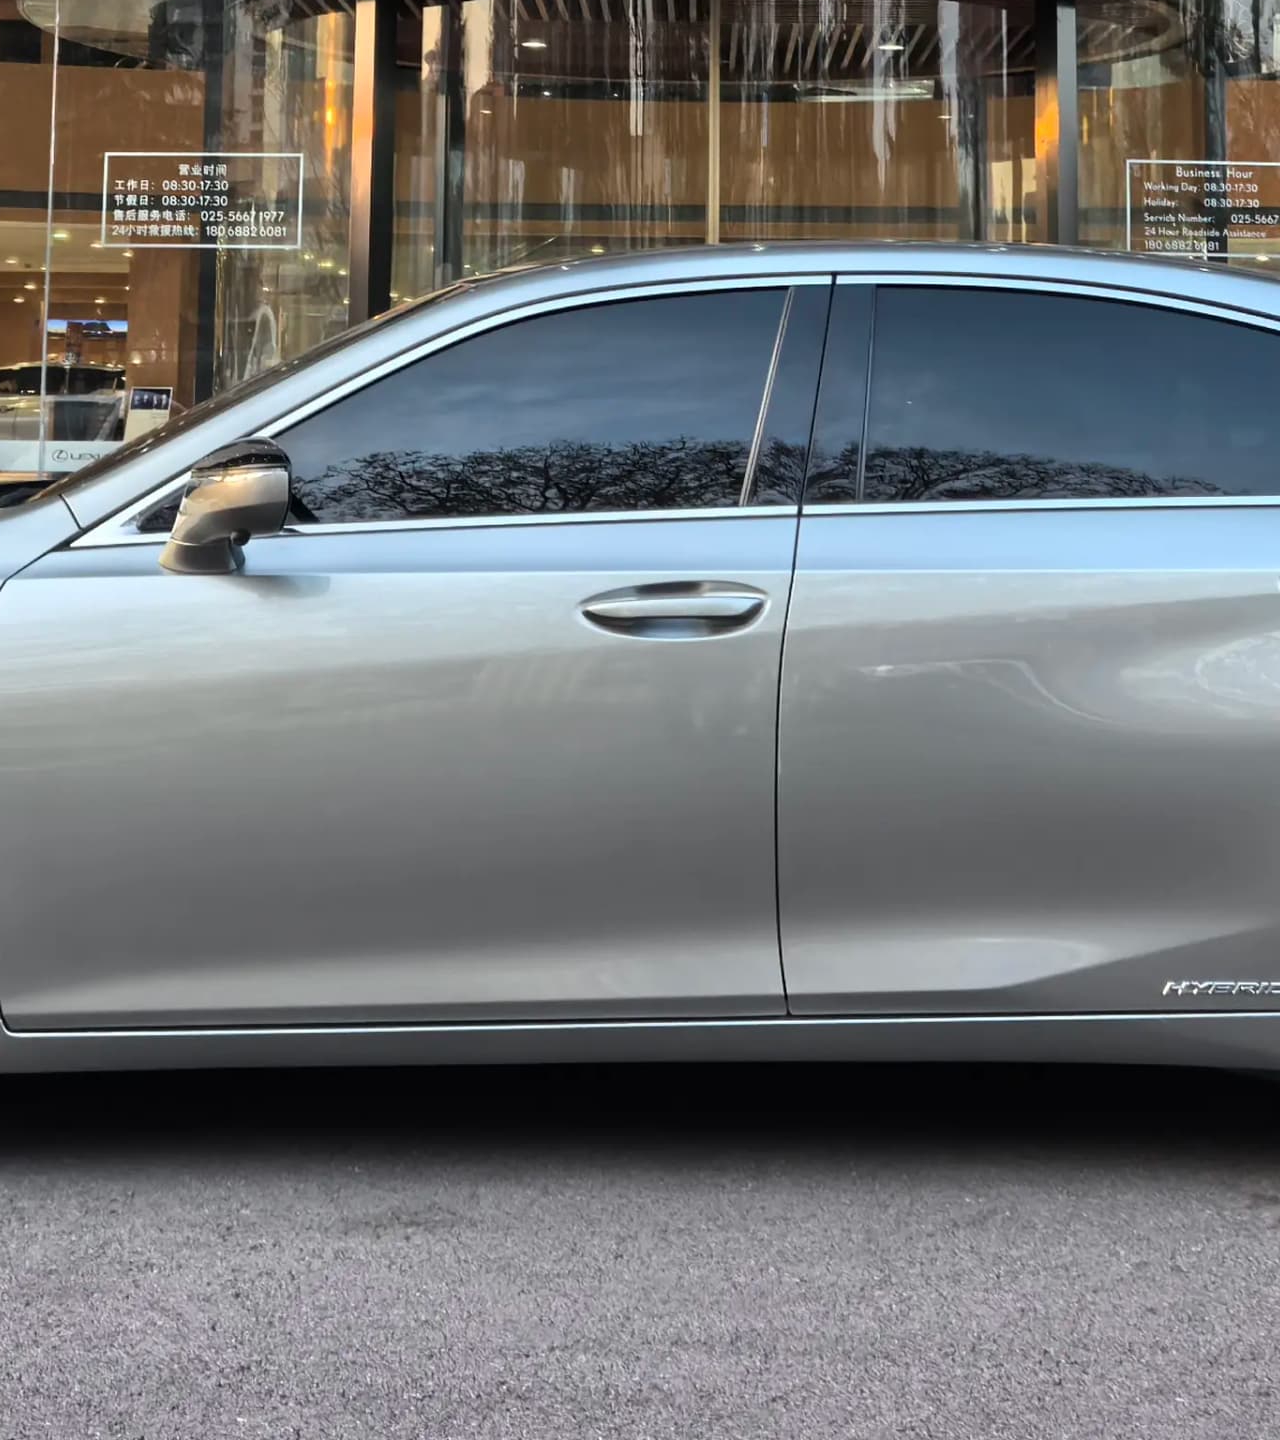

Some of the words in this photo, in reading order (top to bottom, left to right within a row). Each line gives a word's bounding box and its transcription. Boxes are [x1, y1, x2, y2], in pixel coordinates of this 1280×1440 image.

[178, 164, 227, 177] 营业时间
[1175, 166, 1220, 178] Business
[1226, 168, 1254, 179] Hour
[162, 180, 229, 191] 08:30-17:30
[1144, 182, 1179, 192] Working
[1203, 183, 1258, 193] 08:30-17:30
[161, 195, 228, 206] 08:30-17:30
[1203, 198, 1260, 208] 08:30-17:30
[1231, 214, 1279, 225] 025-5667
